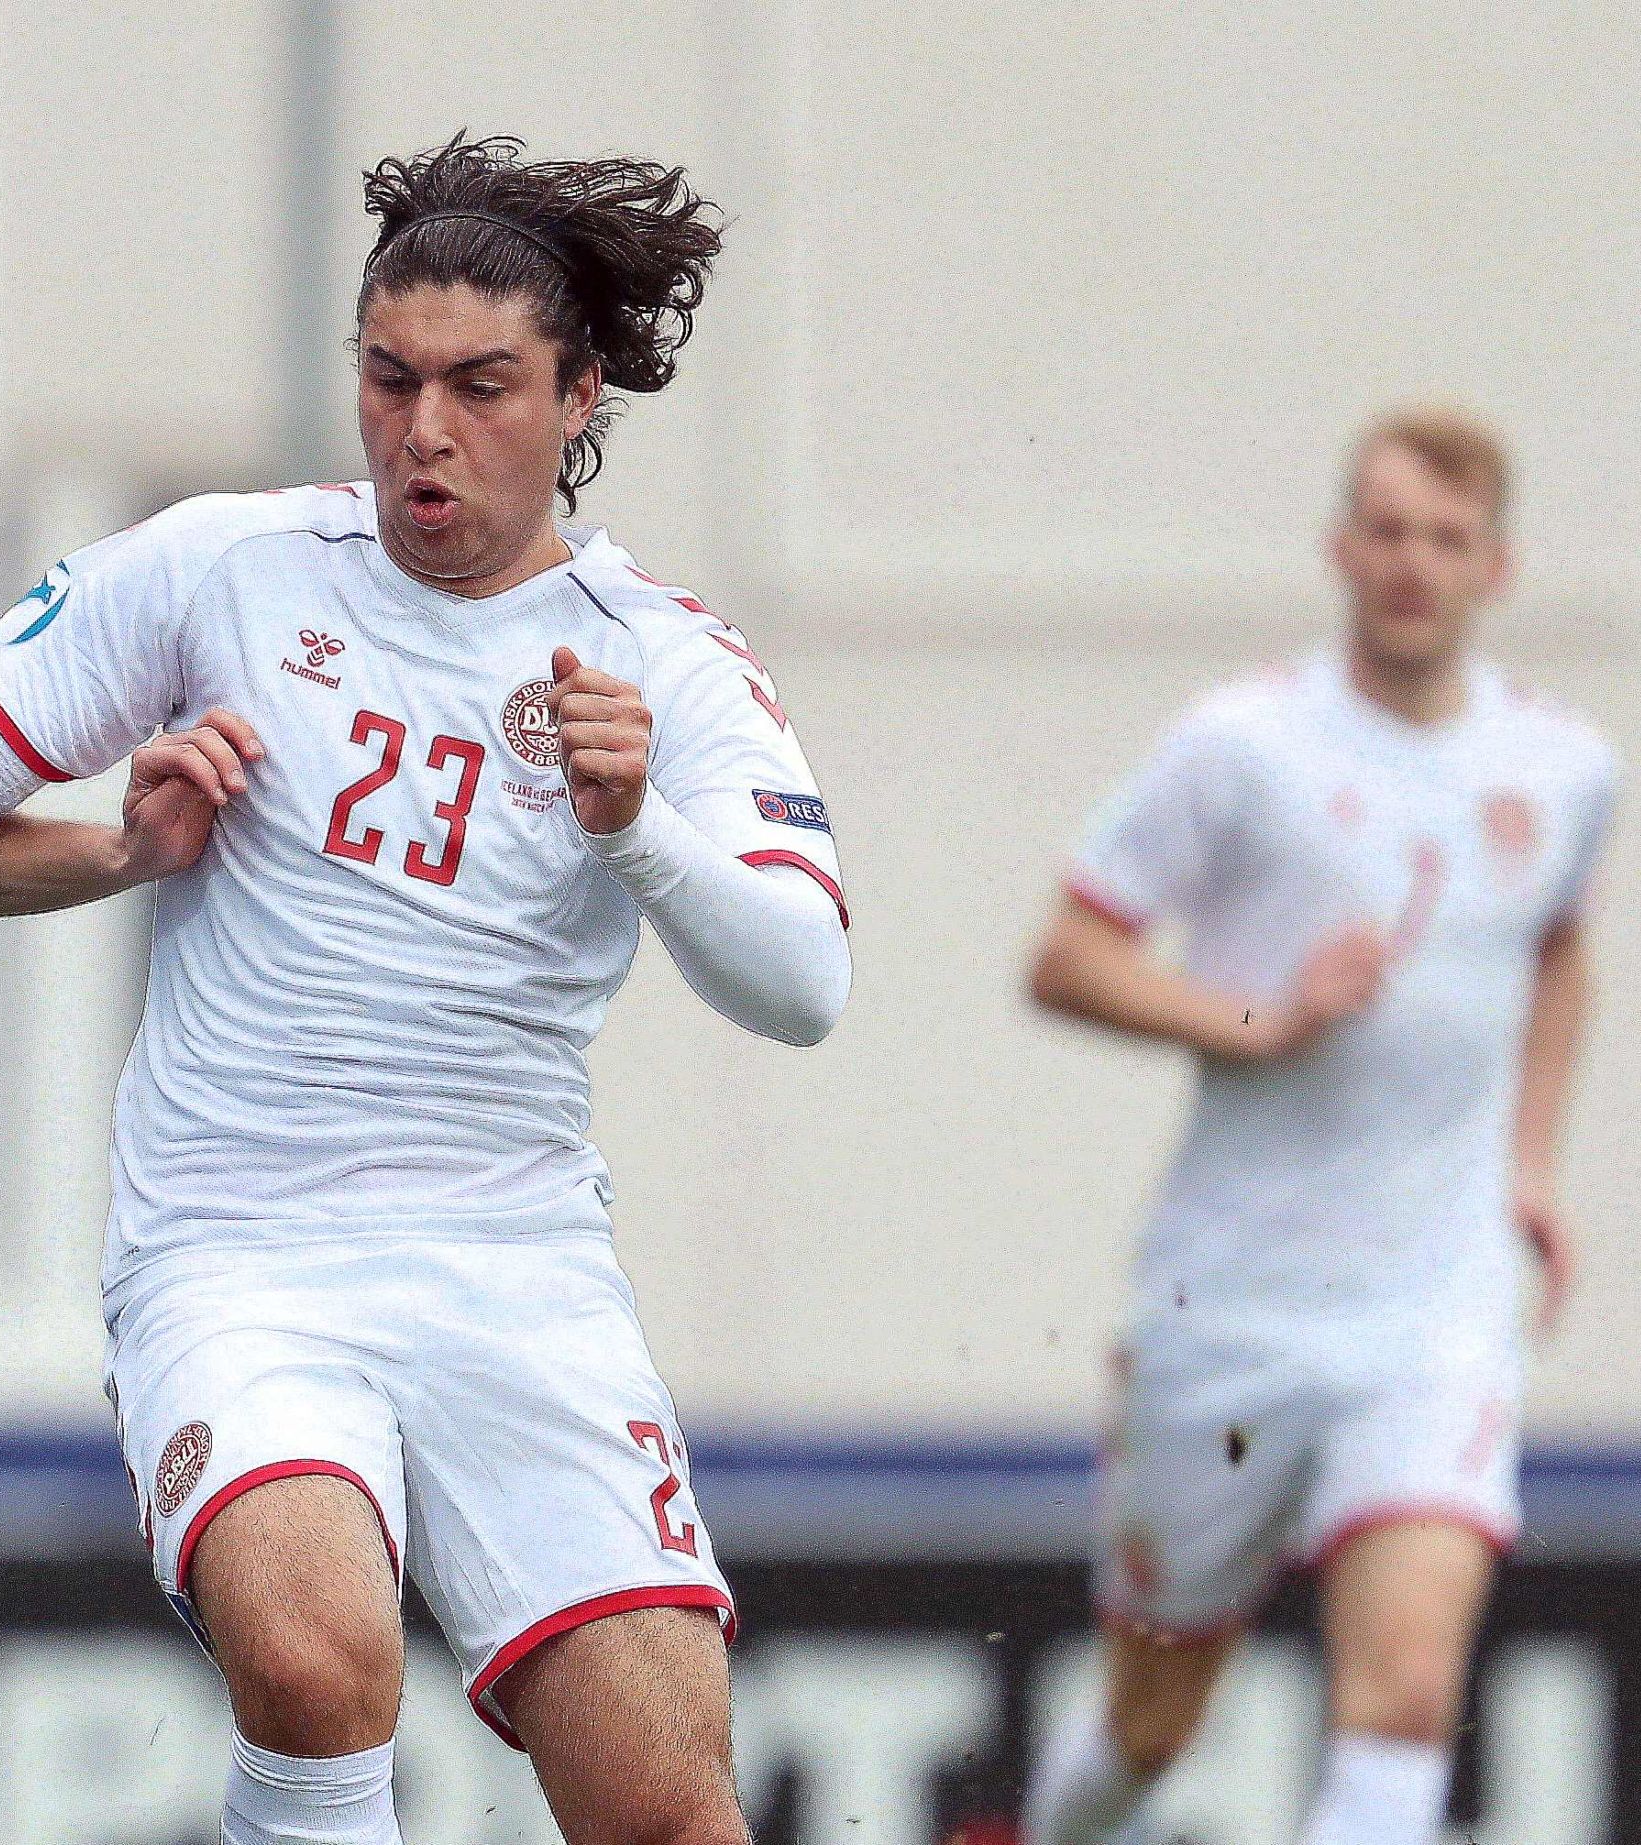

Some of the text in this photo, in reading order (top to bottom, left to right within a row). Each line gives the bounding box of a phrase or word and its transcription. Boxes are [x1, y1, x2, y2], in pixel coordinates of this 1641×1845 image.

[280, 657, 342, 690] hummel
[322, 708, 487, 887] 23
[788, 801, 828, 824] RES
[164, 1437, 198, 1495] DBU
[626, 1419, 699, 1560] 2
